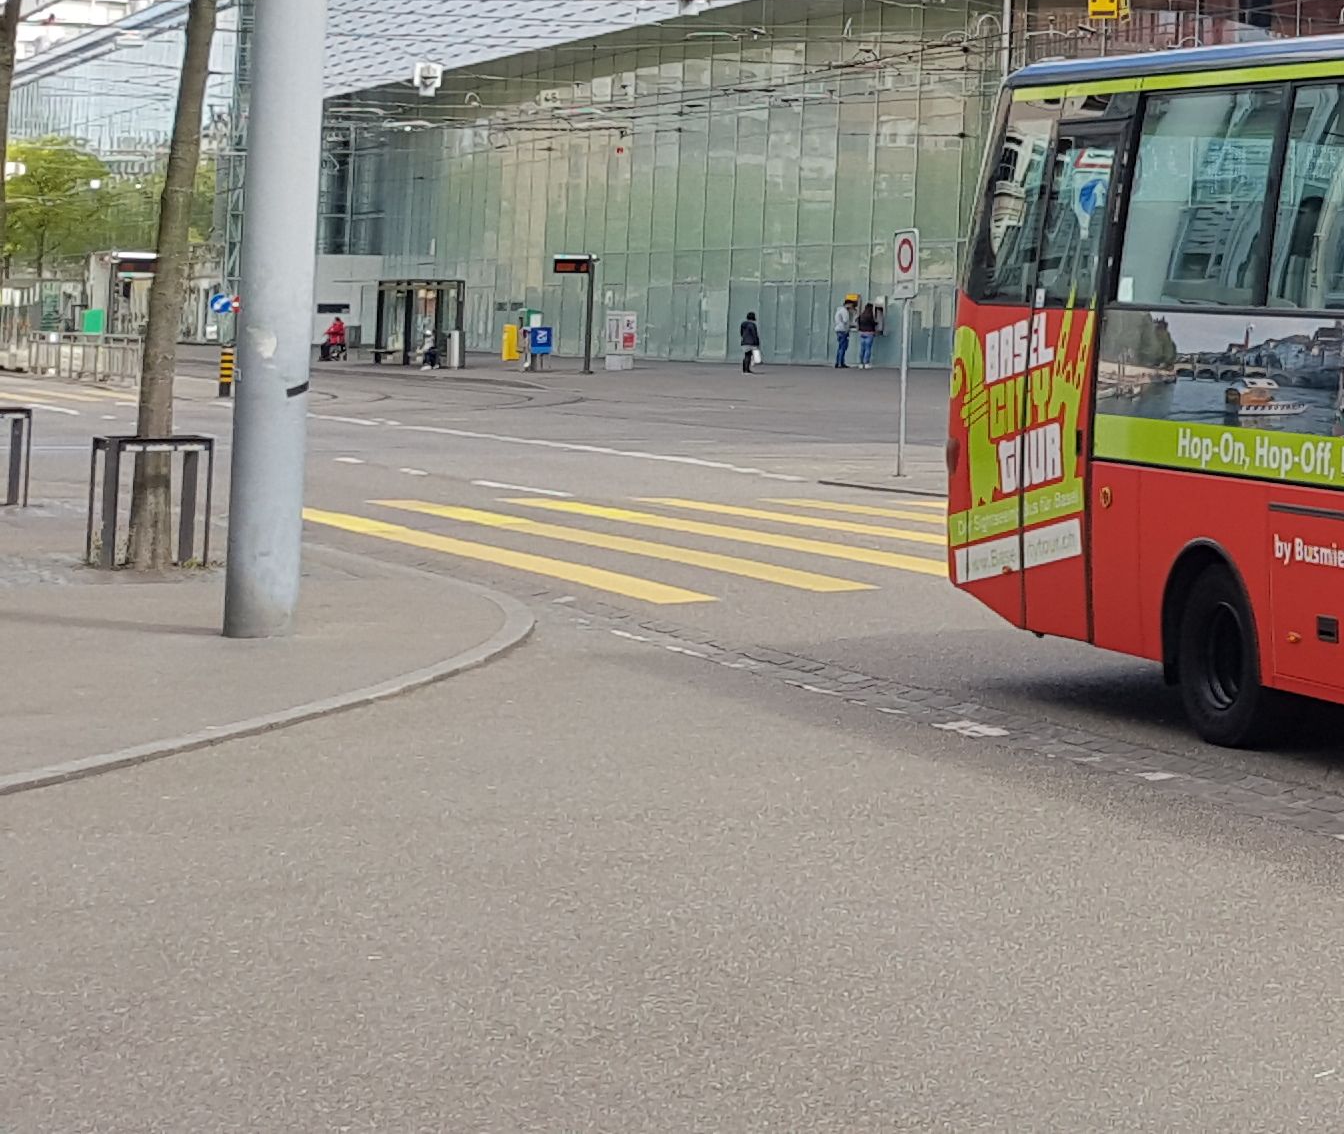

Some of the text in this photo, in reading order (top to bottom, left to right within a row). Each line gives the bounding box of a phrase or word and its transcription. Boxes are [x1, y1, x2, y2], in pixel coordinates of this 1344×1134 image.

[985, 311, 1055, 384] BASEL
[1177, 428, 1249, 468] Hop-On,
[1255, 436, 1335, 479] Hop-Off,
[1273, 533, 1292, 565] by
